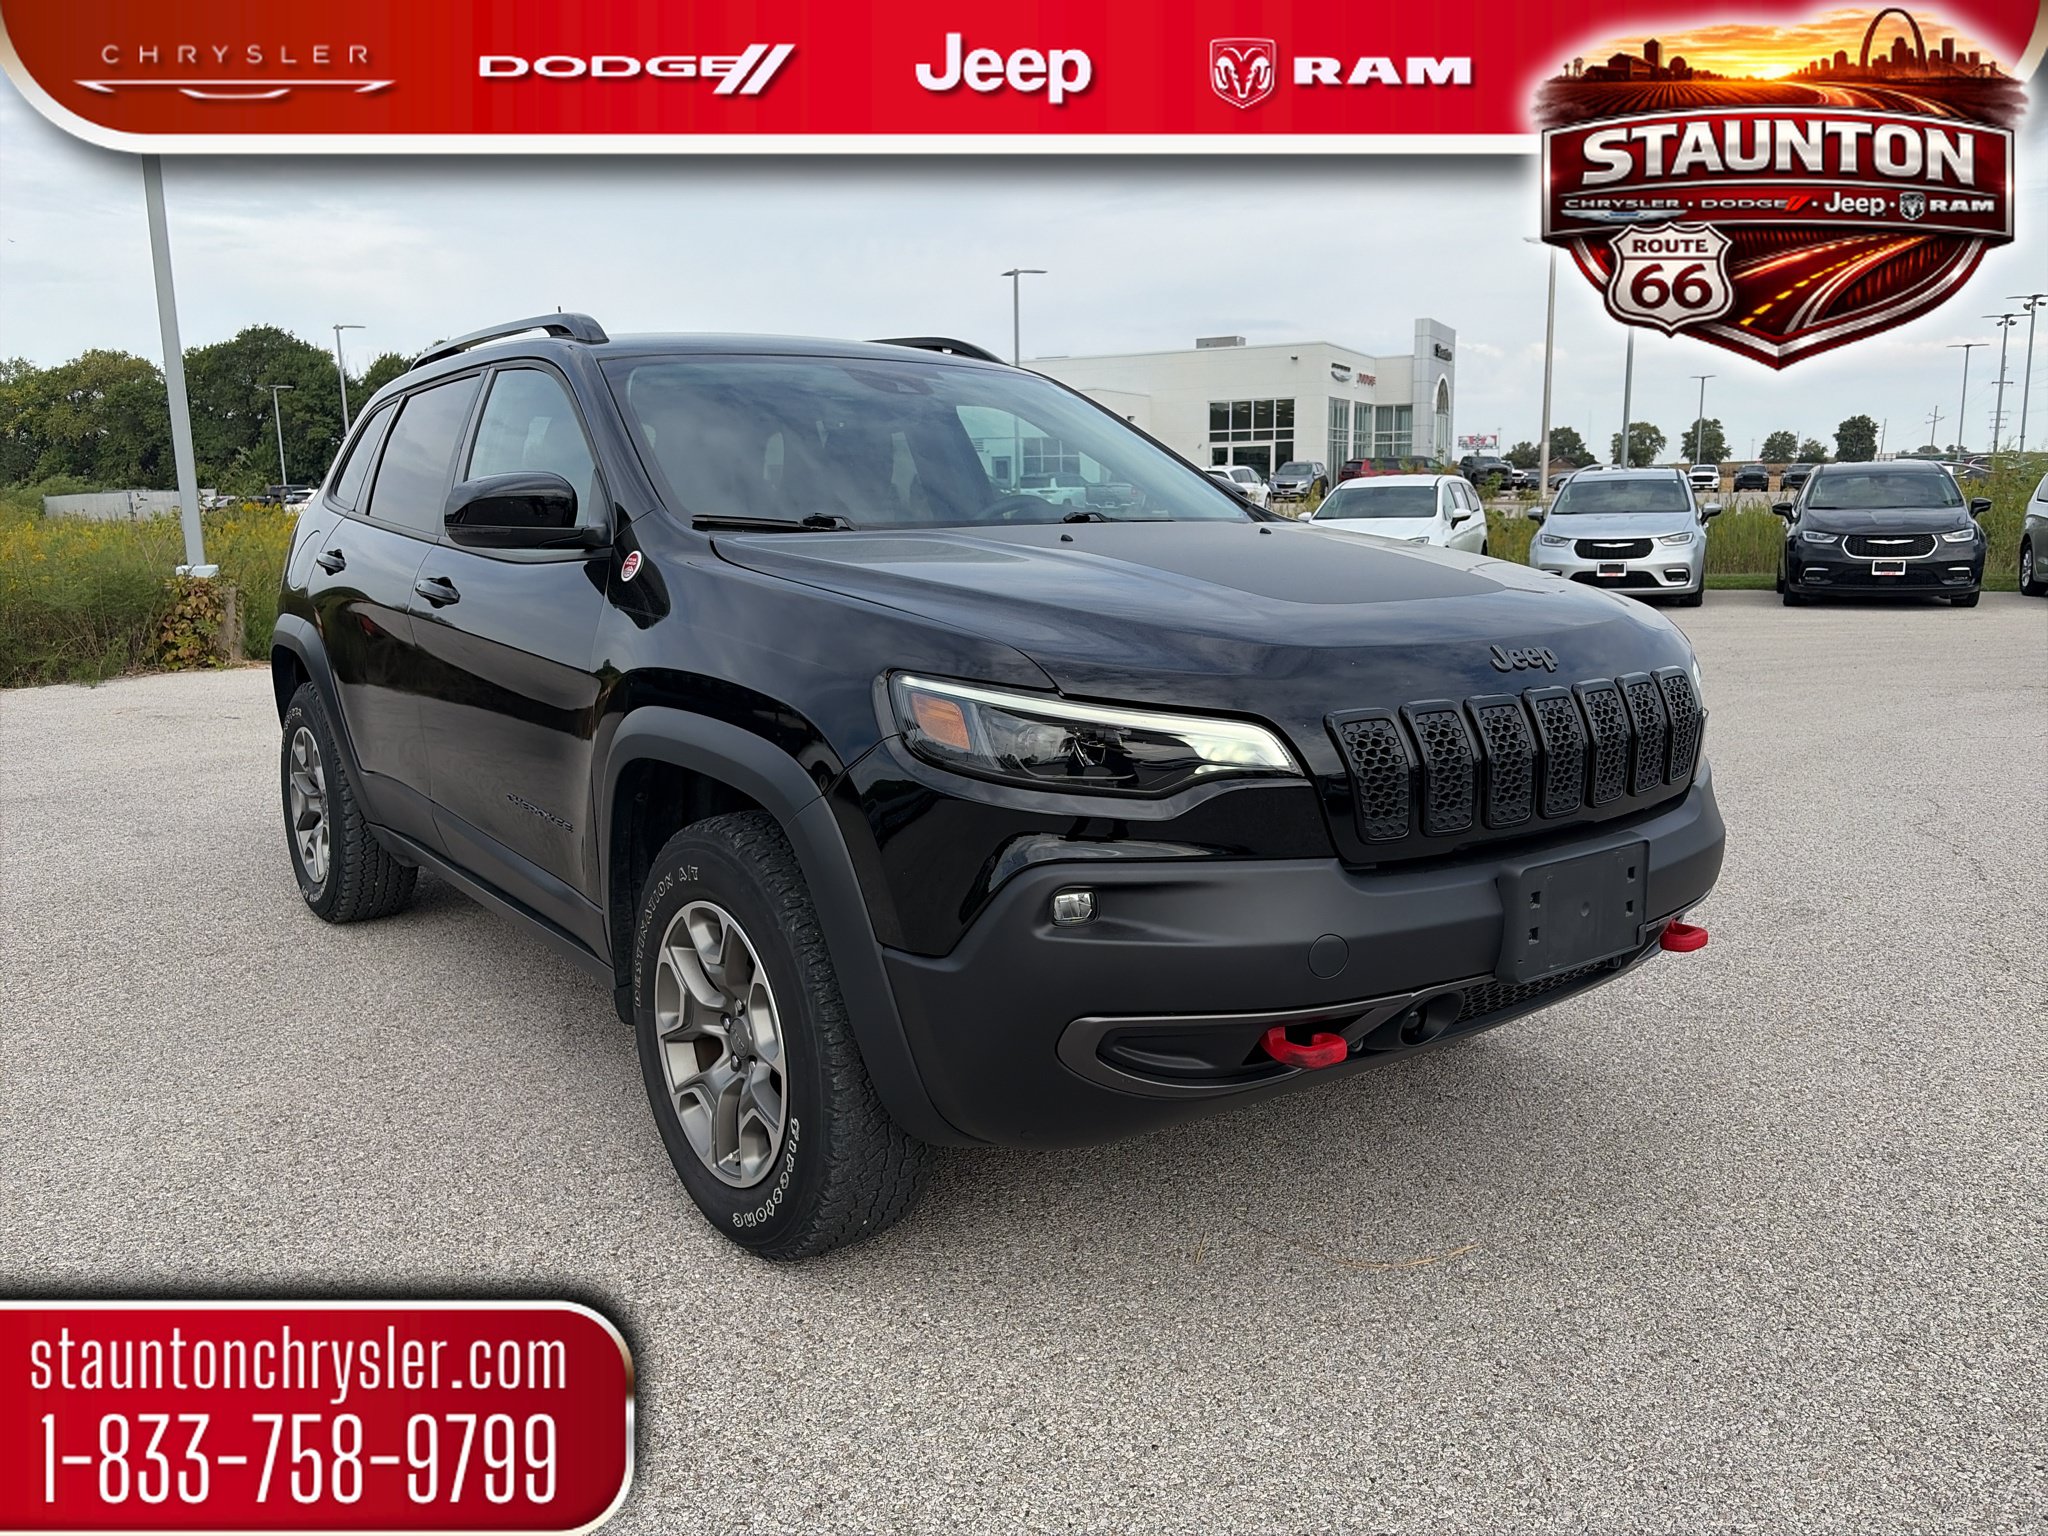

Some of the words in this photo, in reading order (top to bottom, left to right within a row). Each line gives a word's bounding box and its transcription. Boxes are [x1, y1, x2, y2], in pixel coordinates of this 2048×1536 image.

[1490, 644, 1559, 673] Jeep
[507, 793, 574, 834] CHEROKEE
[634, 872, 674, 1008] DESTINATION
[678, 864, 699, 882] A/T
